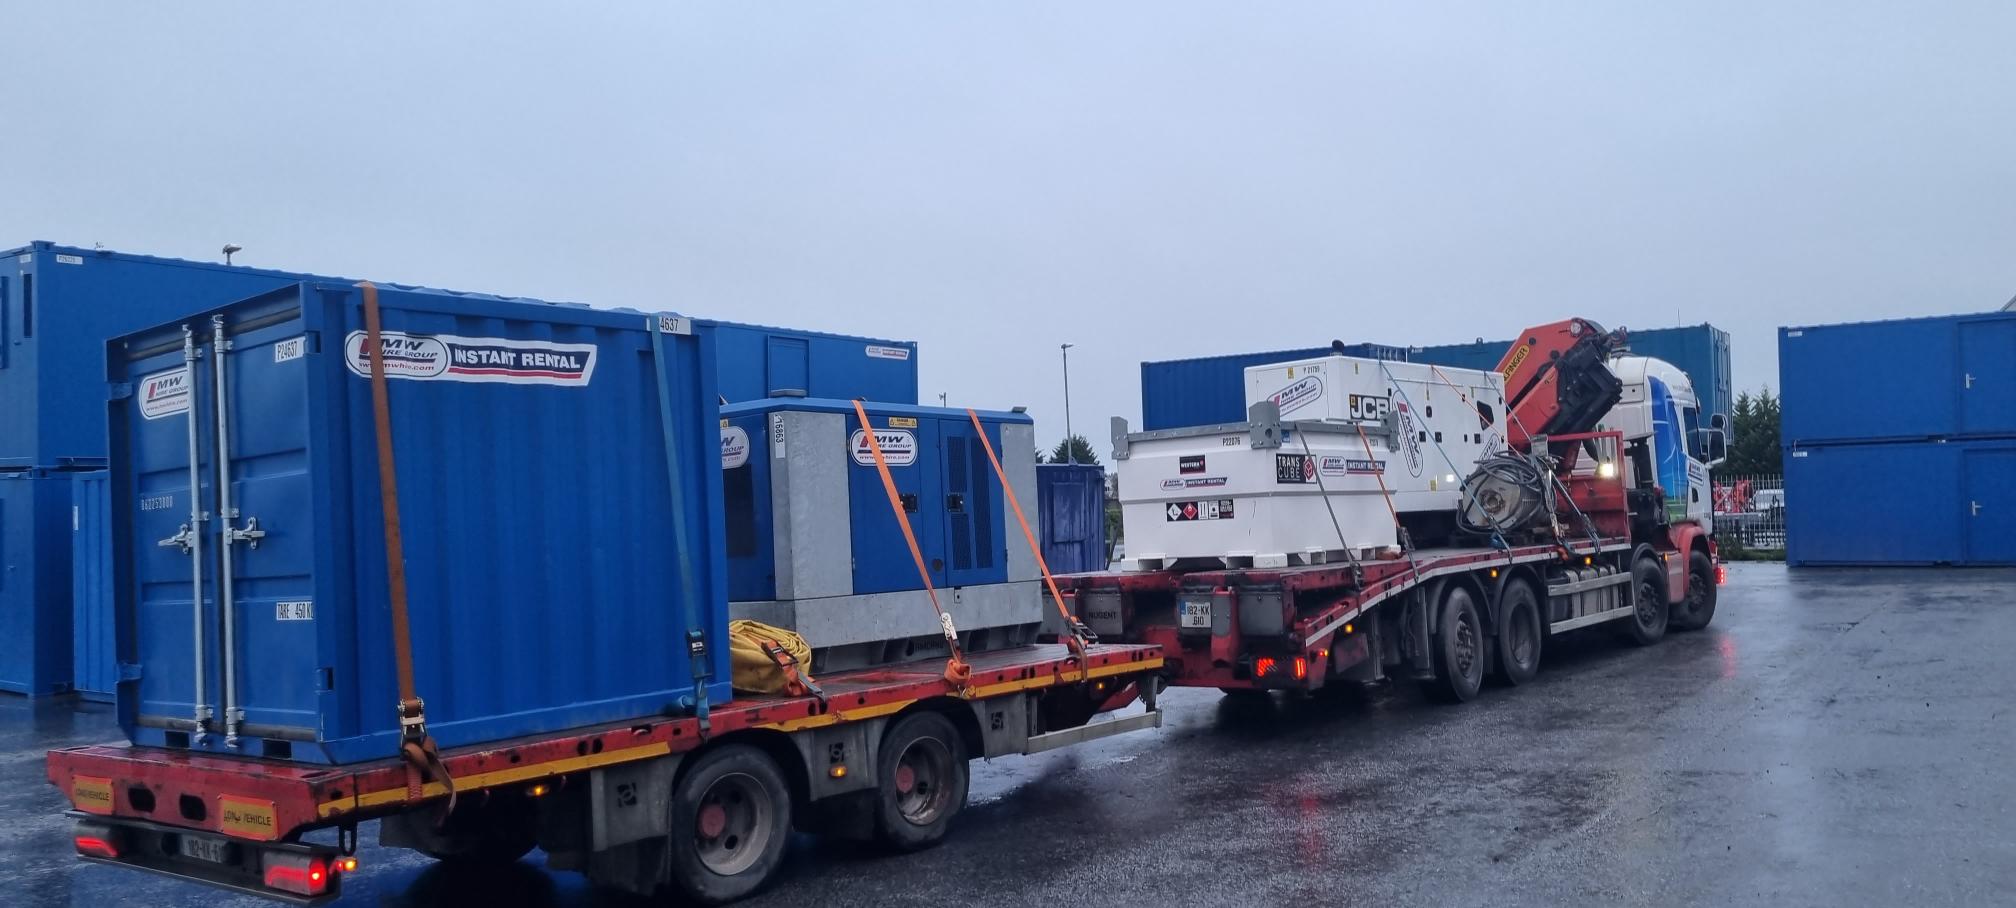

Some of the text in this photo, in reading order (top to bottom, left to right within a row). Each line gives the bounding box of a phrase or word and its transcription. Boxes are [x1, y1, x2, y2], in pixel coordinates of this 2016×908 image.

[660, 317, 678, 331] 4637
[404, 350, 438, 358] GROUP
[455, 349, 580, 368] INSTANT RENTAL
[1350, 395, 1390, 419] JCB
[1277, 455, 1300, 467] TRANS
[1348, 461, 1367, 470] INSTANT
[1278, 467, 1300, 478] CUBE
[1089, 611, 1116, 620] NUGENT
